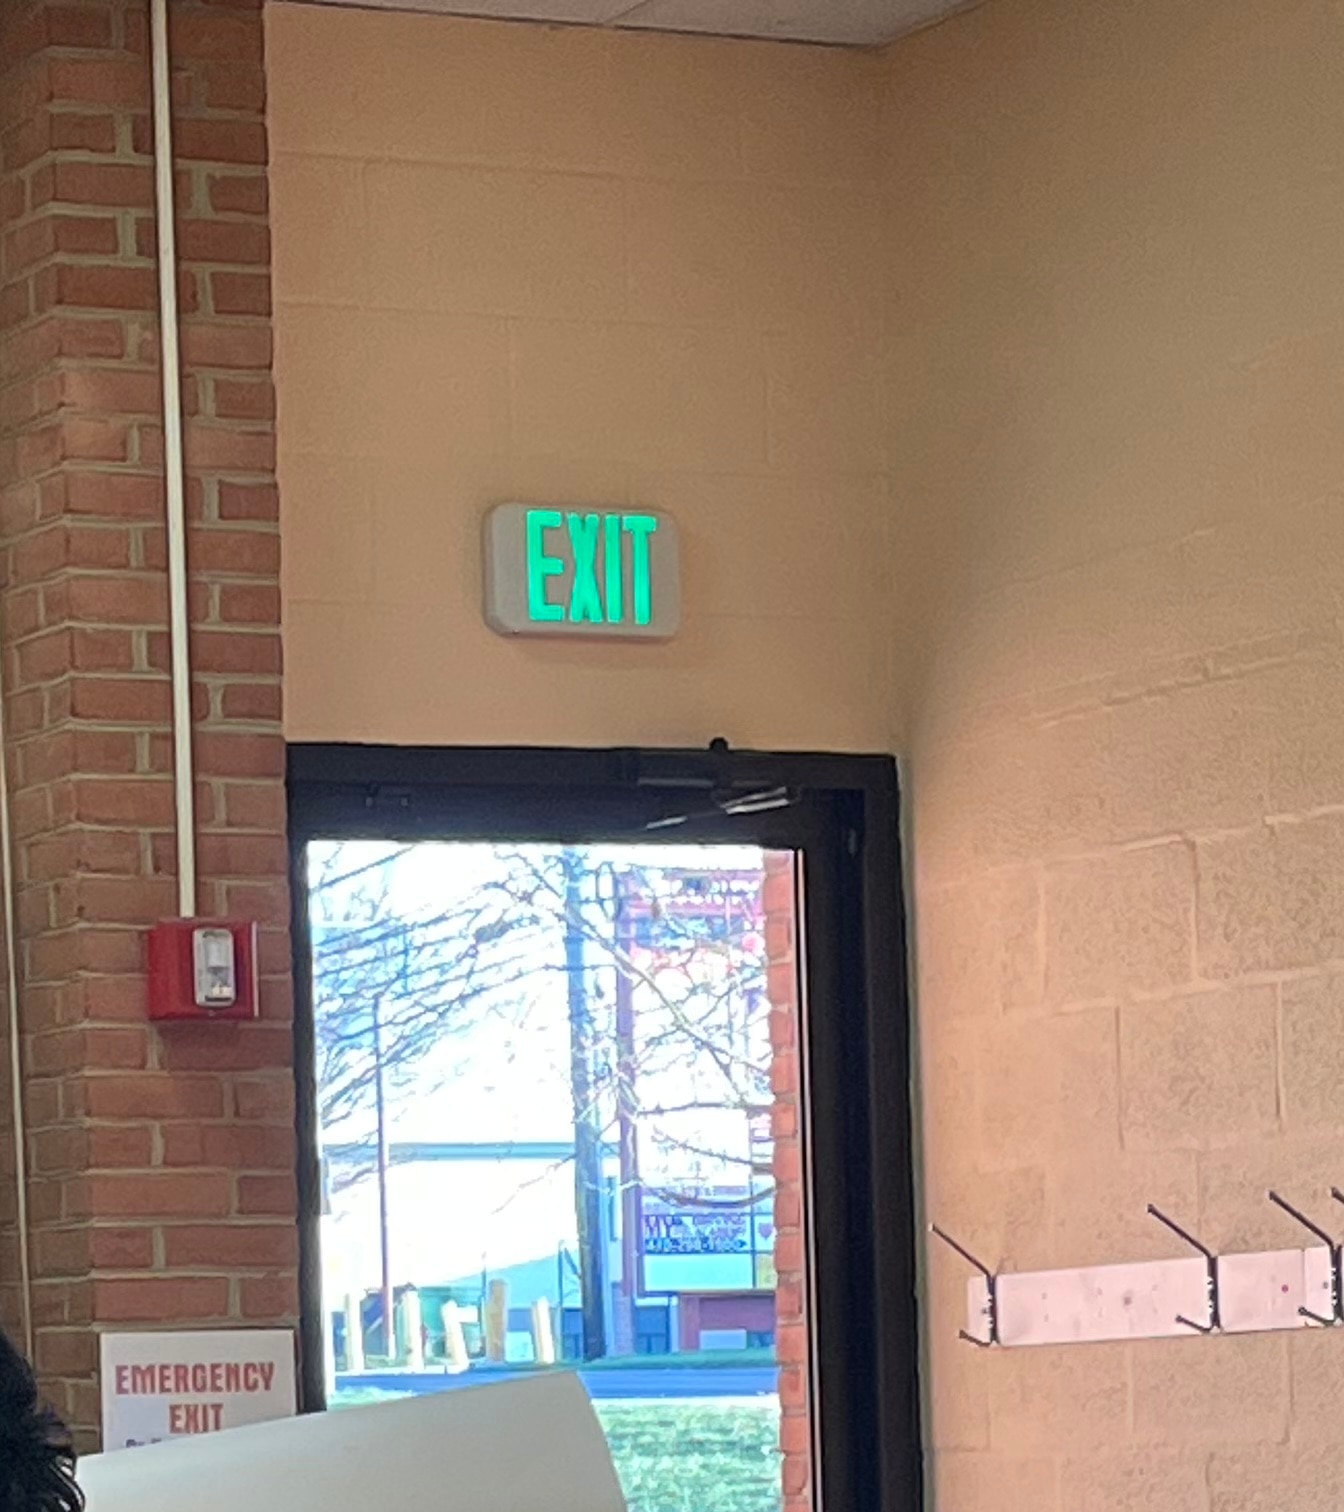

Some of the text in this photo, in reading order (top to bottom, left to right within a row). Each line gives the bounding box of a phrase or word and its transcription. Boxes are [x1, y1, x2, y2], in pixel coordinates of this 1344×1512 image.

[526, 510, 657, 625] EXIT
[115, 1361, 275, 1395] EMERGENCY
[169, 1403, 223, 1434] EXIT
